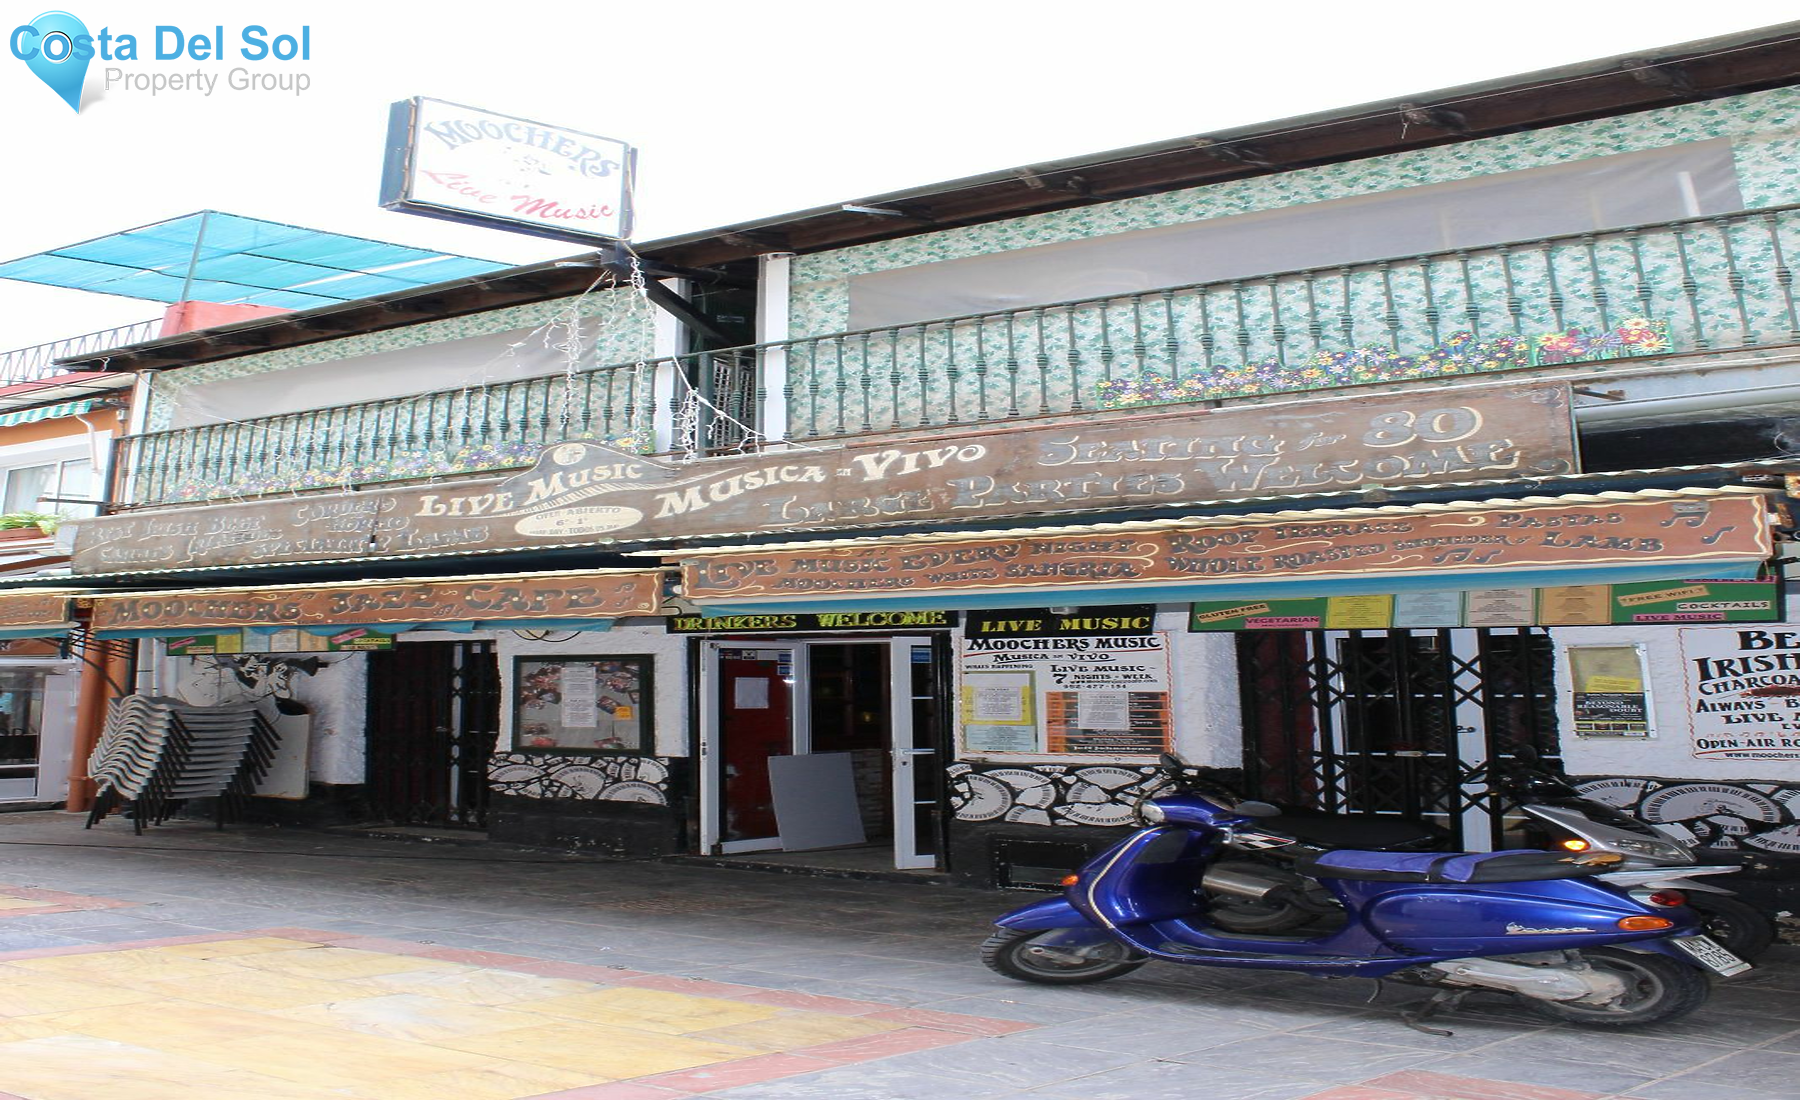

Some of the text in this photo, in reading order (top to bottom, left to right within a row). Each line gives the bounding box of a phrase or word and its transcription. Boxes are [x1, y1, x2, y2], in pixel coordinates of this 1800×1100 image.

[424, 120, 620, 177] MOOCHERS
[420, 170, 614, 219] Live Music
[1037, 433, 1285, 466] SEATING
[1363, 406, 1483, 448] 80
[654, 465, 827, 519] MUSICA
[853, 444, 986, 482] VIVO
[946, 471, 1186, 510] PARTIES
[1194, 438, 1521, 493] WELCOME
[414, 463, 644, 518] LIVE MUSIC
[566, 507, 621, 516] ABIERTO
[1163, 511, 1625, 555] ROOF TERRACE PASTAS
[1164, 555, 1266, 575] WHOLE
[1270, 543, 1388, 570] ROASTED
[1539, 530, 1665, 554] LAMB
[696, 538, 1137, 594] LIVE MUSIC EVERY NIGHT
[772, 575, 915, 591] MOOCHERS
[1004, 560, 1143, 579] SANGRIA
[108, 599, 304, 626] MOOCHERS
[328, 584, 442, 615] JAZZ
[464, 583, 607, 613] CAFE
[1199, 607, 1239, 620] GLUTEN
[1240, 603, 1267, 613] FREE
[1677, 601, 1769, 610] COCKTAILS
[673, 610, 948, 632] DRINKERS WELCOME
[981, 616, 1151, 633] LIVE MUSIC
[1245, 616, 1320, 624] VEGETARIAN
[1635, 613, 1723, 622] LIVE MUSIC
[969, 637, 1163, 651] MOOCHERS MUSIC
[993, 652, 1050, 663] MUSICA
[1067, 652, 1110, 662] VIVO
[1692, 652, 1800, 682] IRISH
[1050, 664, 1089, 673] LIVE
[1052, 673, 1068, 684] 7
[1696, 698, 1766, 713] ALWAYS
[1721, 712, 1785, 725] LIVE
[1696, 738, 1776, 749] OPEN-AIR
